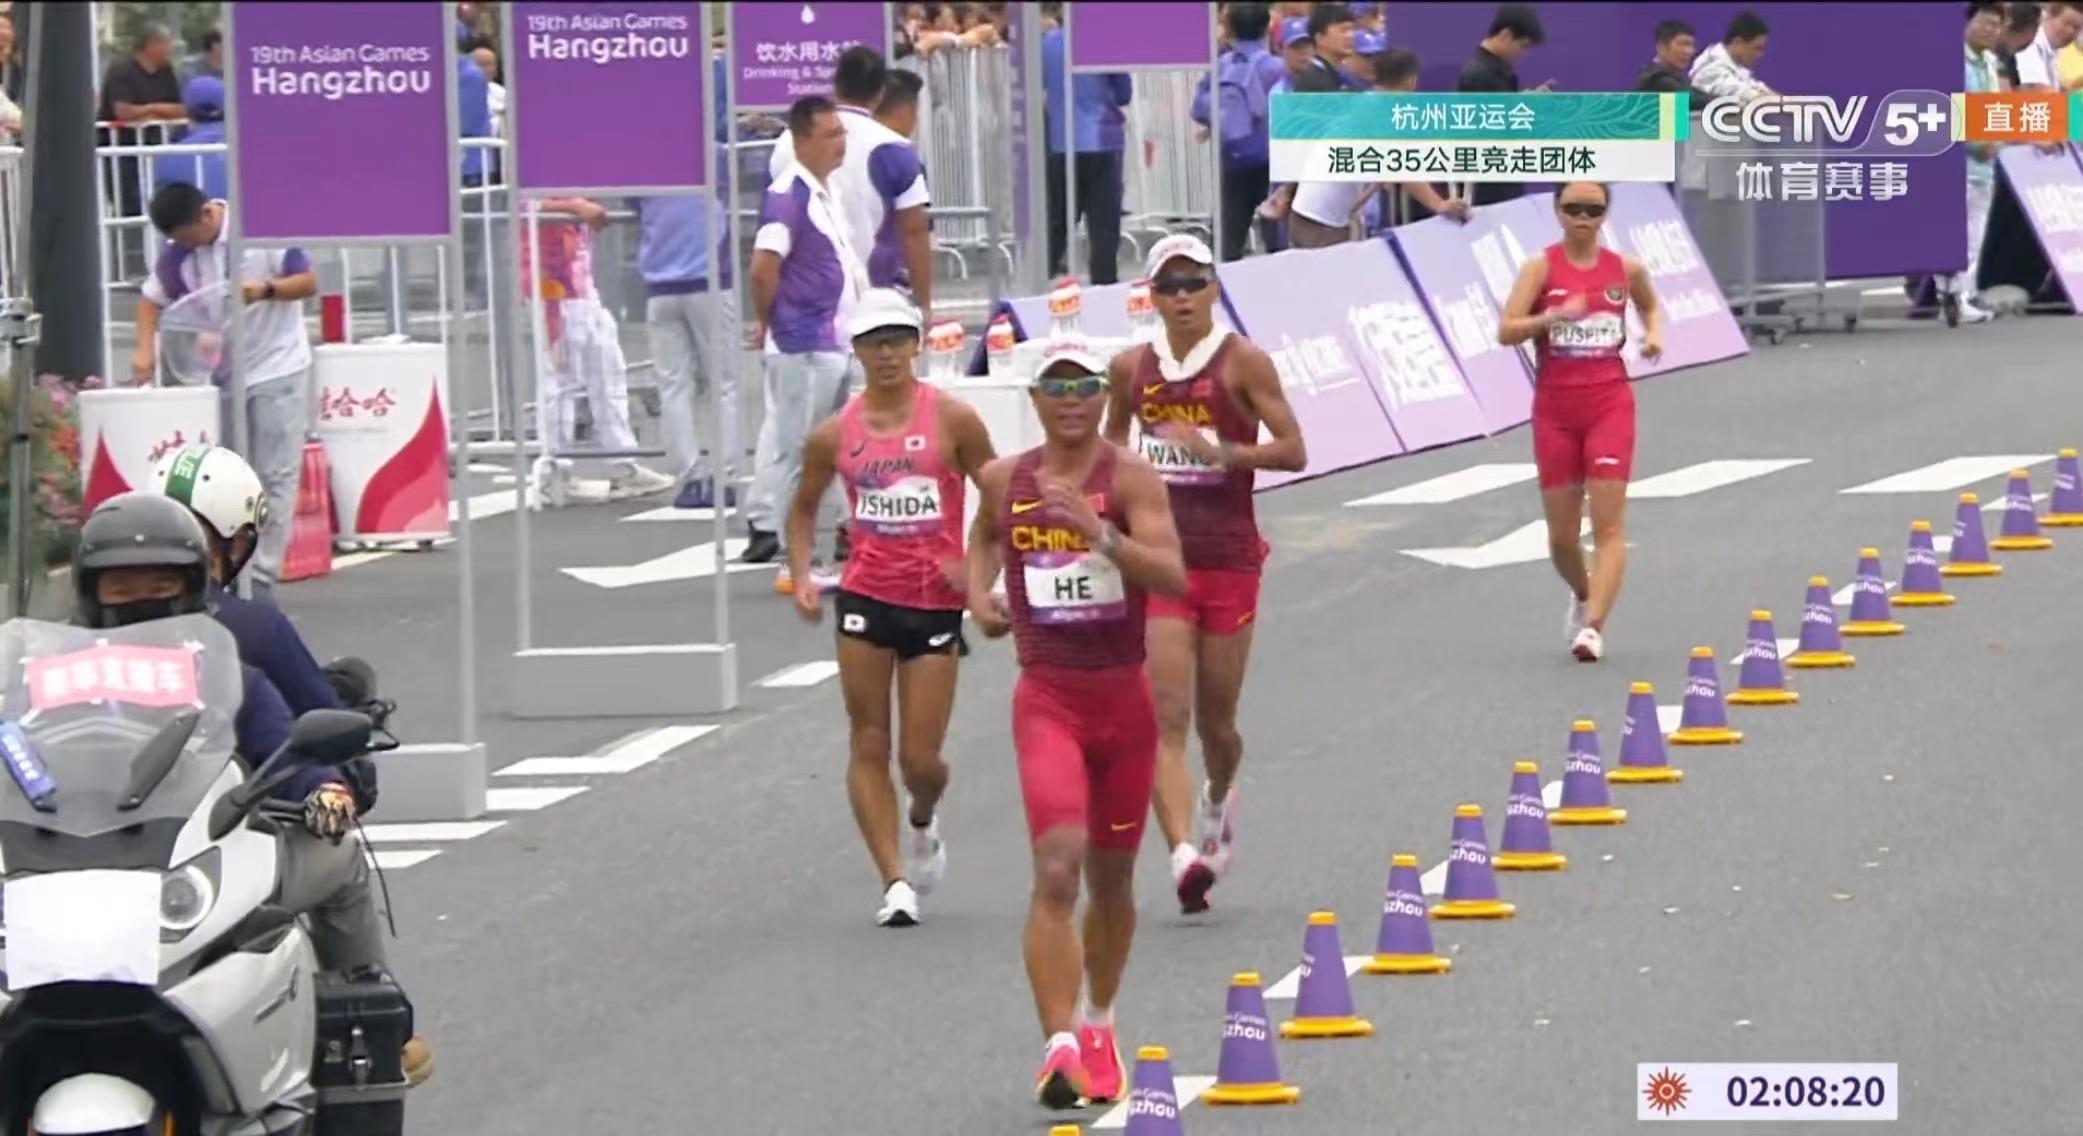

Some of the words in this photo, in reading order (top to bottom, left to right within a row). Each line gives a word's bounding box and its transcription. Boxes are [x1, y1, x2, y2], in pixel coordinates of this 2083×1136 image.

[527, 14, 568, 32] 19th
[570, 14, 621, 31] Asian
[624, 12, 688, 30] Games
[251, 45, 296, 64] 19th
[299, 45, 356, 64] Asian
[358, 44, 430, 62] Games
[528, 33, 689, 64] Hangzhou
[251, 66, 431, 100] Hangzhou
[1141, 402, 1212, 424] CHINA
[1147, 442, 1213, 467] WAN
[862, 458, 914, 475] JAPAN
[861, 495, 937, 516] ISHIDA
[1012, 526, 1084, 551] CHIN
[1054, 576, 1093, 600] HE
